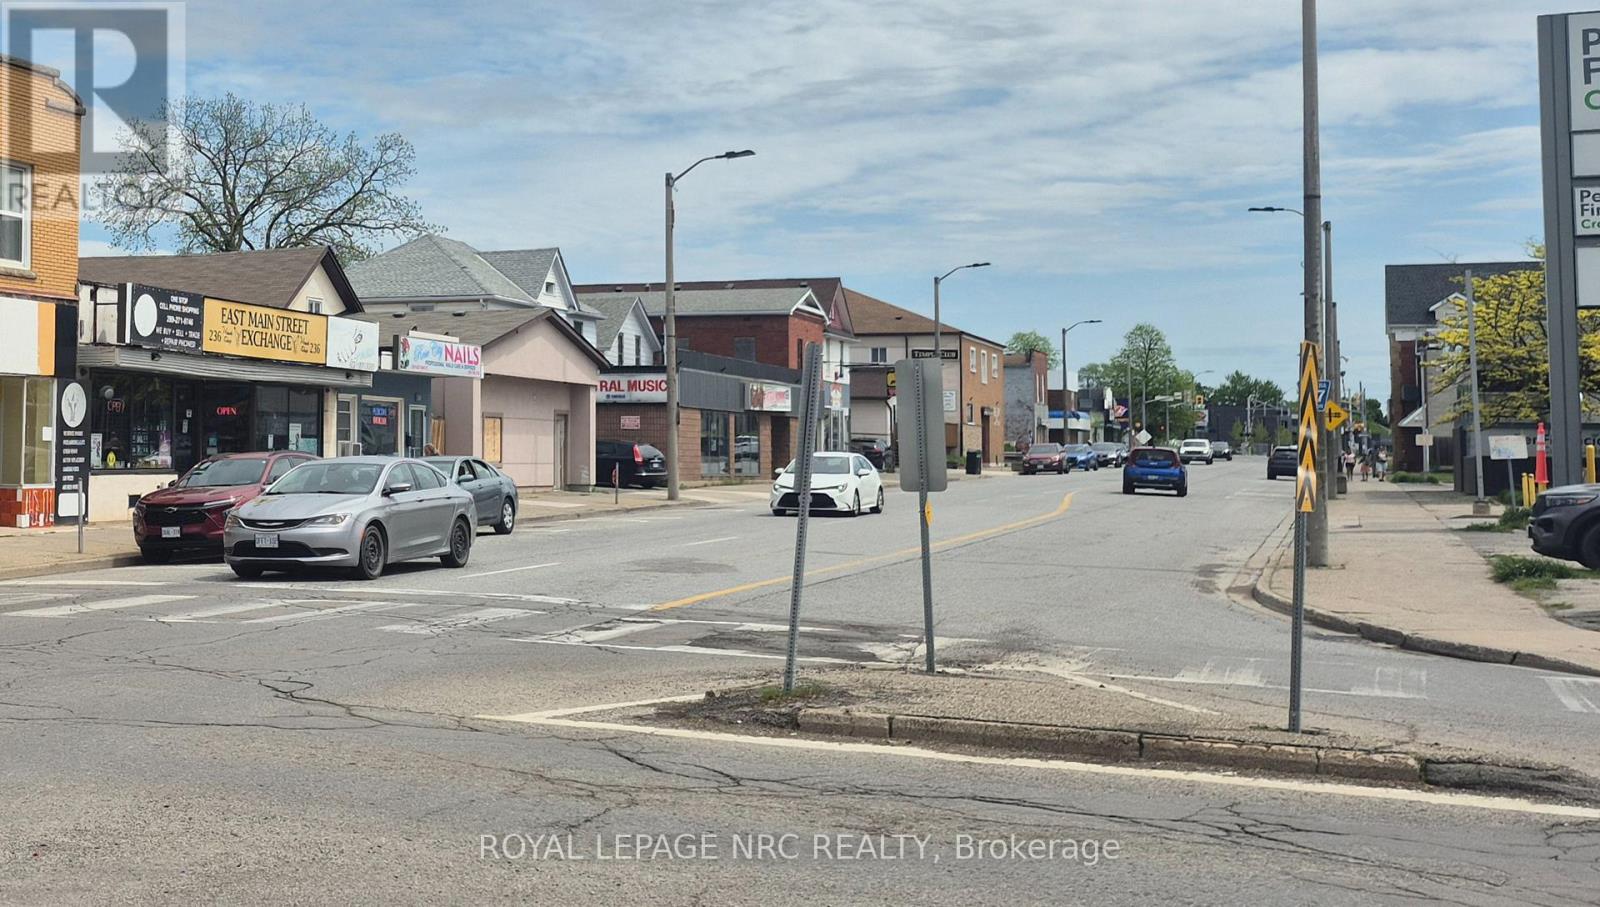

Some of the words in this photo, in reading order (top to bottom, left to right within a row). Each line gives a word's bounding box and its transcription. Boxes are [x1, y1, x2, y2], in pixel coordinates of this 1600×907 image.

[159, 302, 169, 310] CELL
[169, 303, 181, 312] PHONE
[181, 305, 199, 315] SHOPPING
[221, 307, 246, 326] EAST
[248, 311, 274, 330] MAIN
[276, 315, 309, 335] STREET
[163, 327, 171, 335] BUY
[175, 329, 184, 337] SELL
[188, 330, 200, 339] TRADE
[209, 329, 221, 343] 236
[241, 329, 293, 351] EXCHANGE
[309, 342, 321, 354] 236
[445, 343, 479, 366] NAILS
[595, 380, 625, 392] RAL
[627, 379, 668, 392] MUSIC
[216, 406, 238, 416] OPEN
